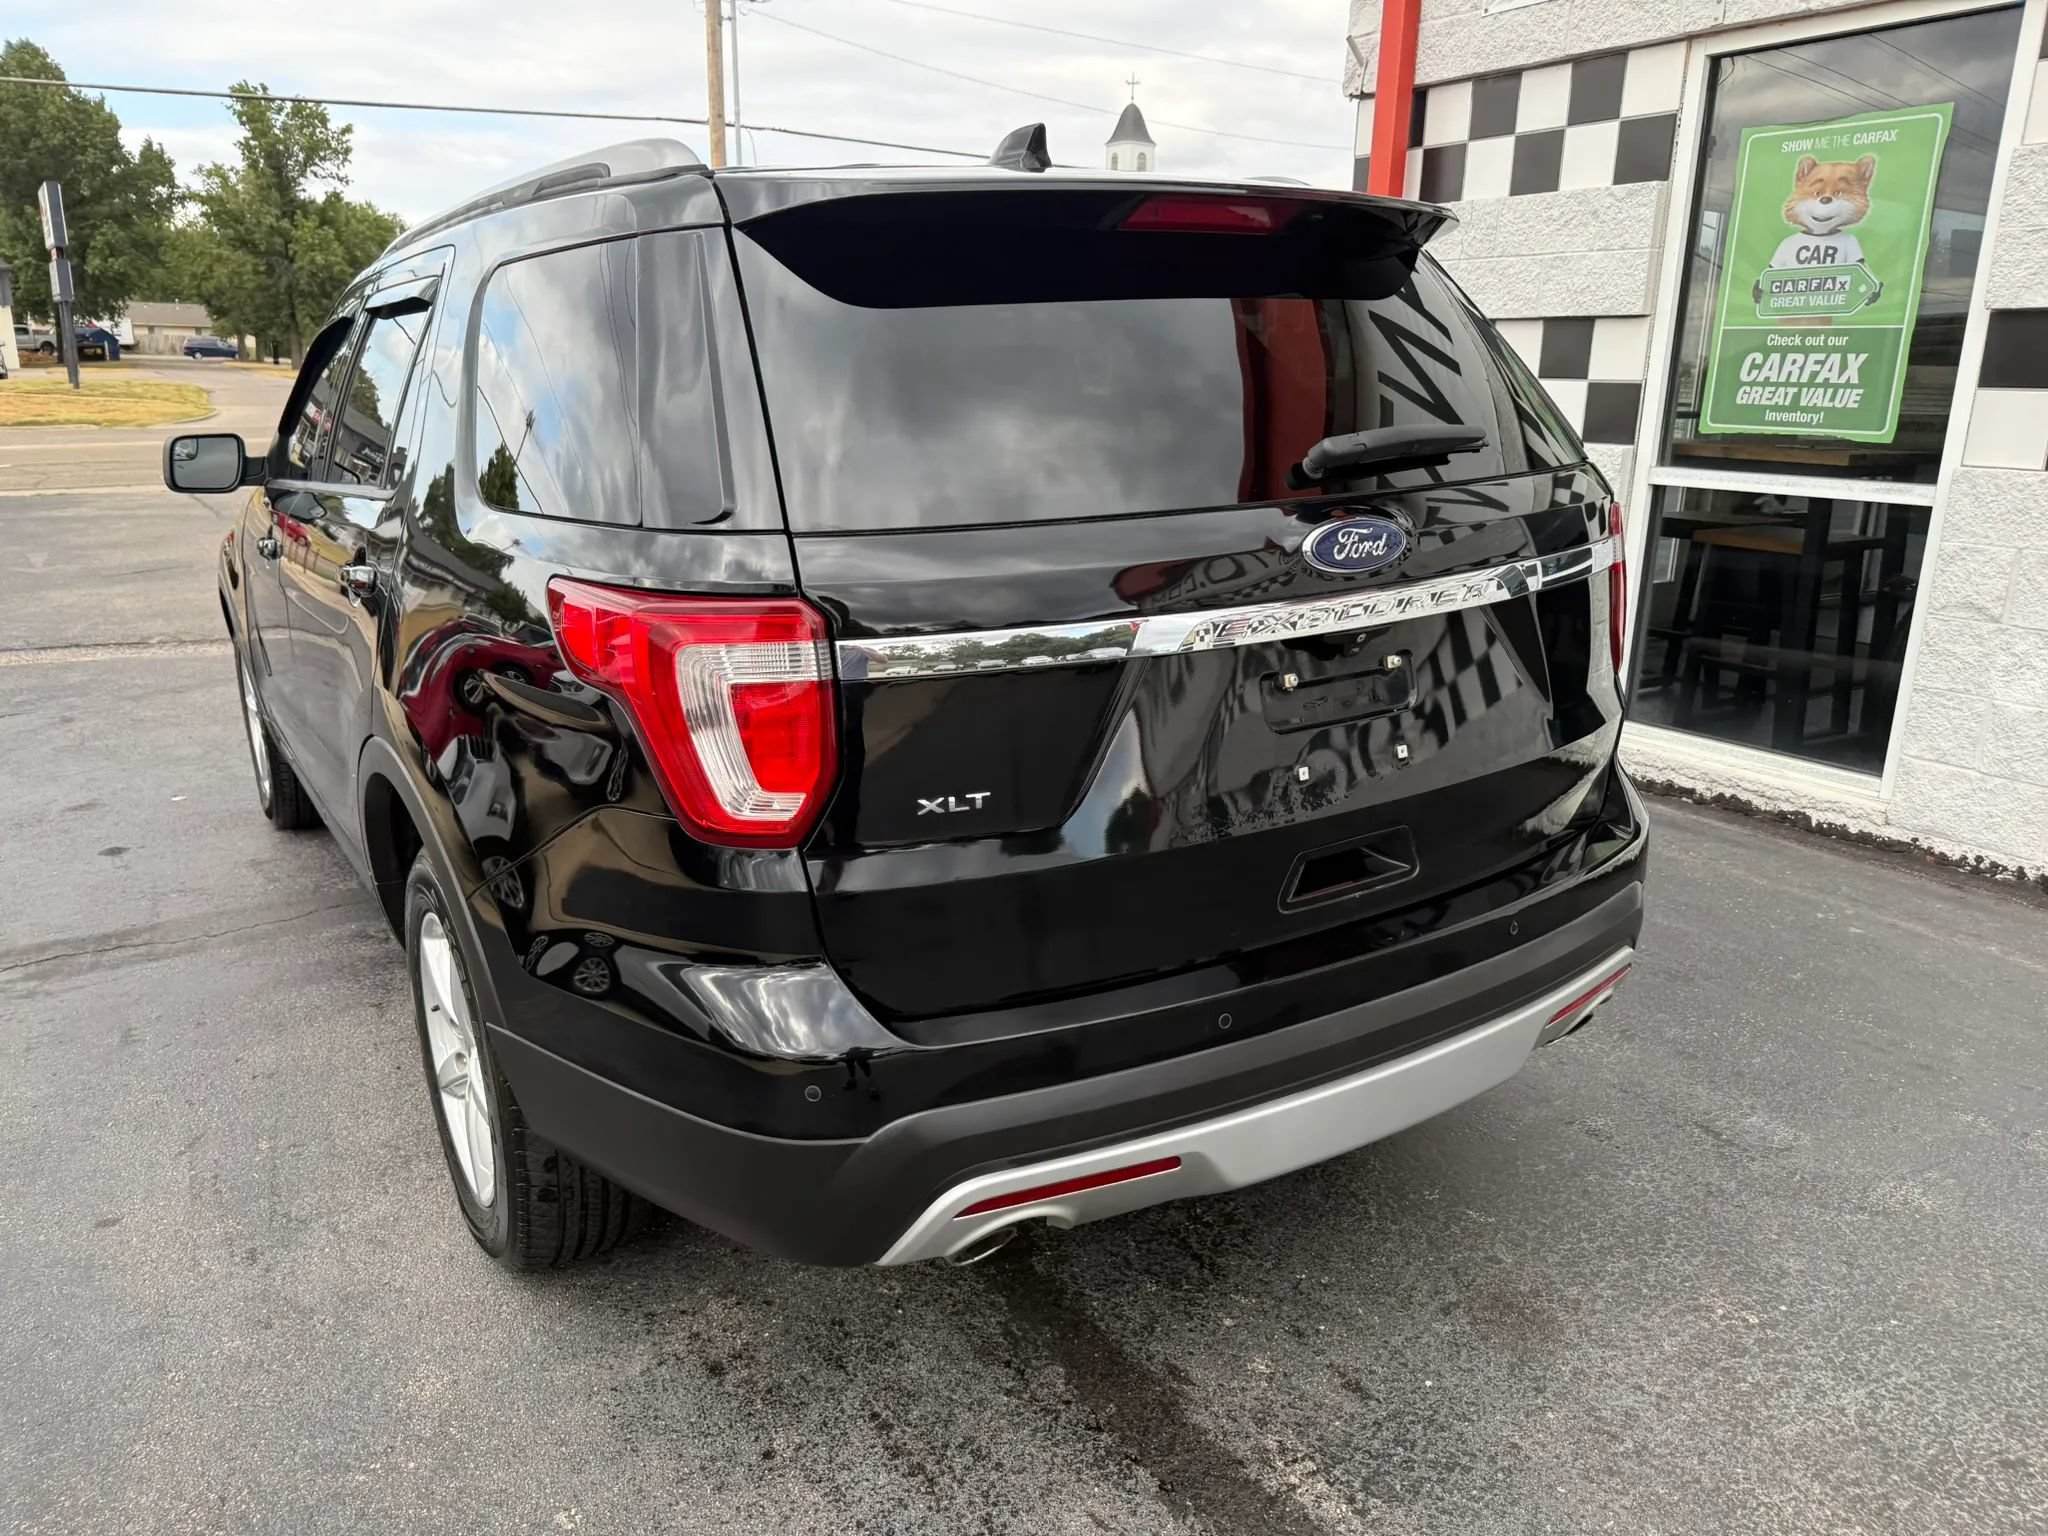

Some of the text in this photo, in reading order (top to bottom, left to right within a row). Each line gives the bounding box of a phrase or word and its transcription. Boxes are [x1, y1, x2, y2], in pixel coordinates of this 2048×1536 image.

[1781, 129, 1899, 152] SHOW ME THE CARFAX
[1795, 245, 1838, 265] CAR
[1771, 277, 1850, 294] CARFAX
[1770, 294, 1846, 308] GREAT VALUE
[1767, 334, 1849, 346] Check out our
[1740, 352, 1869, 383] CARFAX
[1736, 386, 1864, 408] GREAT VALUE
[1765, 410, 1825, 425] Inventory!
[1333, 527, 1387, 560] Ford
[917, 792, 991, 815] XLT
